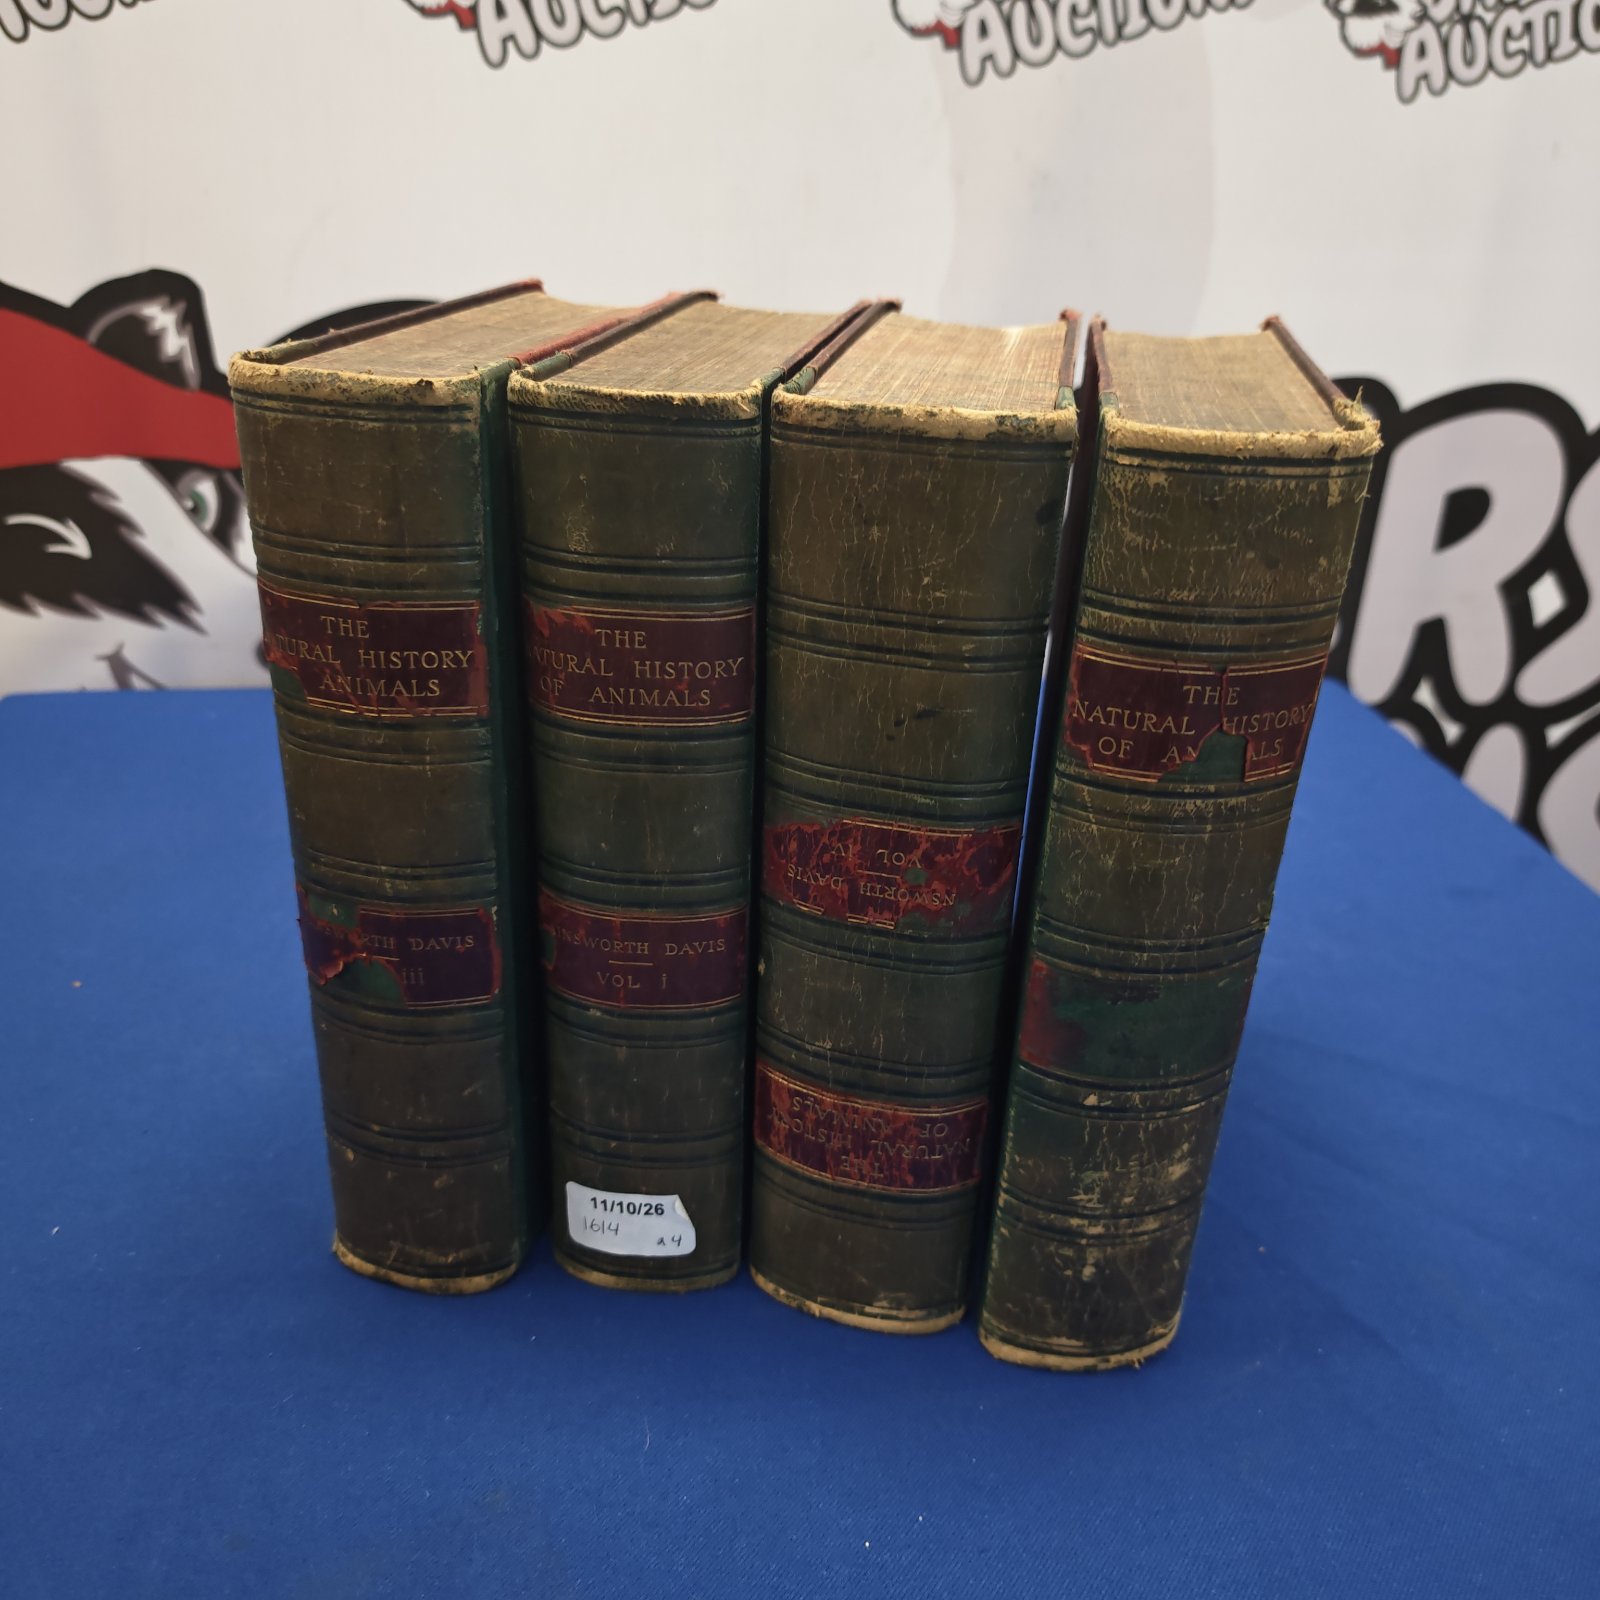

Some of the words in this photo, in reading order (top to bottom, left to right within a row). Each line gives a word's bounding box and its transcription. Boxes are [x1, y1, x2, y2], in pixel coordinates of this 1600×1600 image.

[320, 616, 370, 639] THE
[595, 629, 647, 649] THE
[275, 633, 341, 664] TURAL
[358, 649, 474, 670] HISTORY
[634, 657, 745, 680] HISTORY
[319, 673, 442, 698] ANIMALS
[541, 675, 565, 697] OF
[588, 686, 712, 708] ANIMALS
[1183, 685, 1241, 706] THE
[1072, 699, 1196, 736] NATURAL
[1223, 703, 1313, 736] HISTORY
[1098, 736, 1135, 759] OF
[876, 849, 923, 869] VOL
[786, 863, 846, 890] DAVIS
[409, 935, 475, 951] DAVIS
[665, 938, 726, 957] DAVIS
[596, 971, 641, 989] VOL
[920, 1122, 949, 1139] OF
[870, 1138, 971, 1160] NATURAL
[840, 1155, 885, 1178] THE
[590, 1196, 665, 1216] 11/10/26
[584, 1216, 620, 1236] 1614
